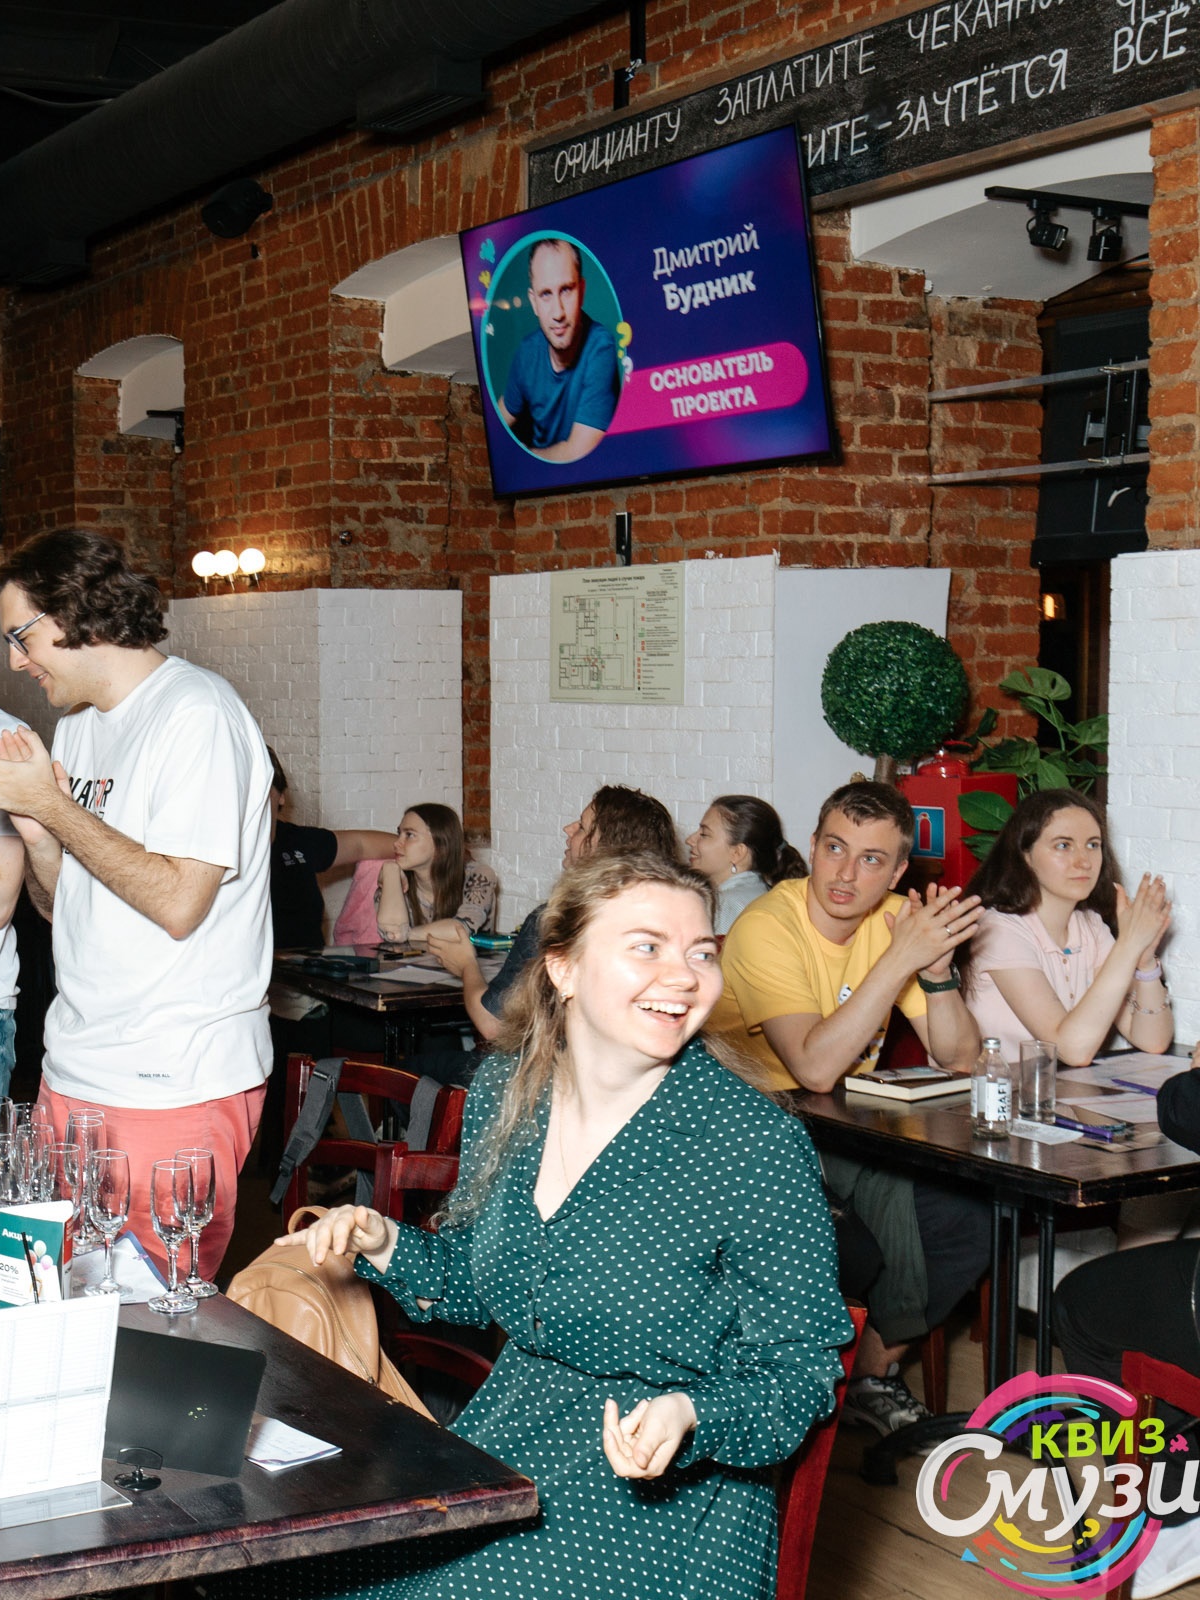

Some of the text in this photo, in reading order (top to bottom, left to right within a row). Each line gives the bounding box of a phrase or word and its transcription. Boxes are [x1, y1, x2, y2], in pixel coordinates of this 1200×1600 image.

[554, 107, 681, 184] ОФИЦИАНТУ
[713, 34, 876, 125] ЗАПЛАТИТЕ
[652, 222, 760, 280] Дмитрий
[662, 270, 757, 315] Будник
[650, 351, 774, 392] ОСНОВАТЕЛЬ
[670, 385, 758, 418] ПРОЕКТА
[1, 1228, 33, 1243] Акци
[0, 1262, 19, 1275] 20%
